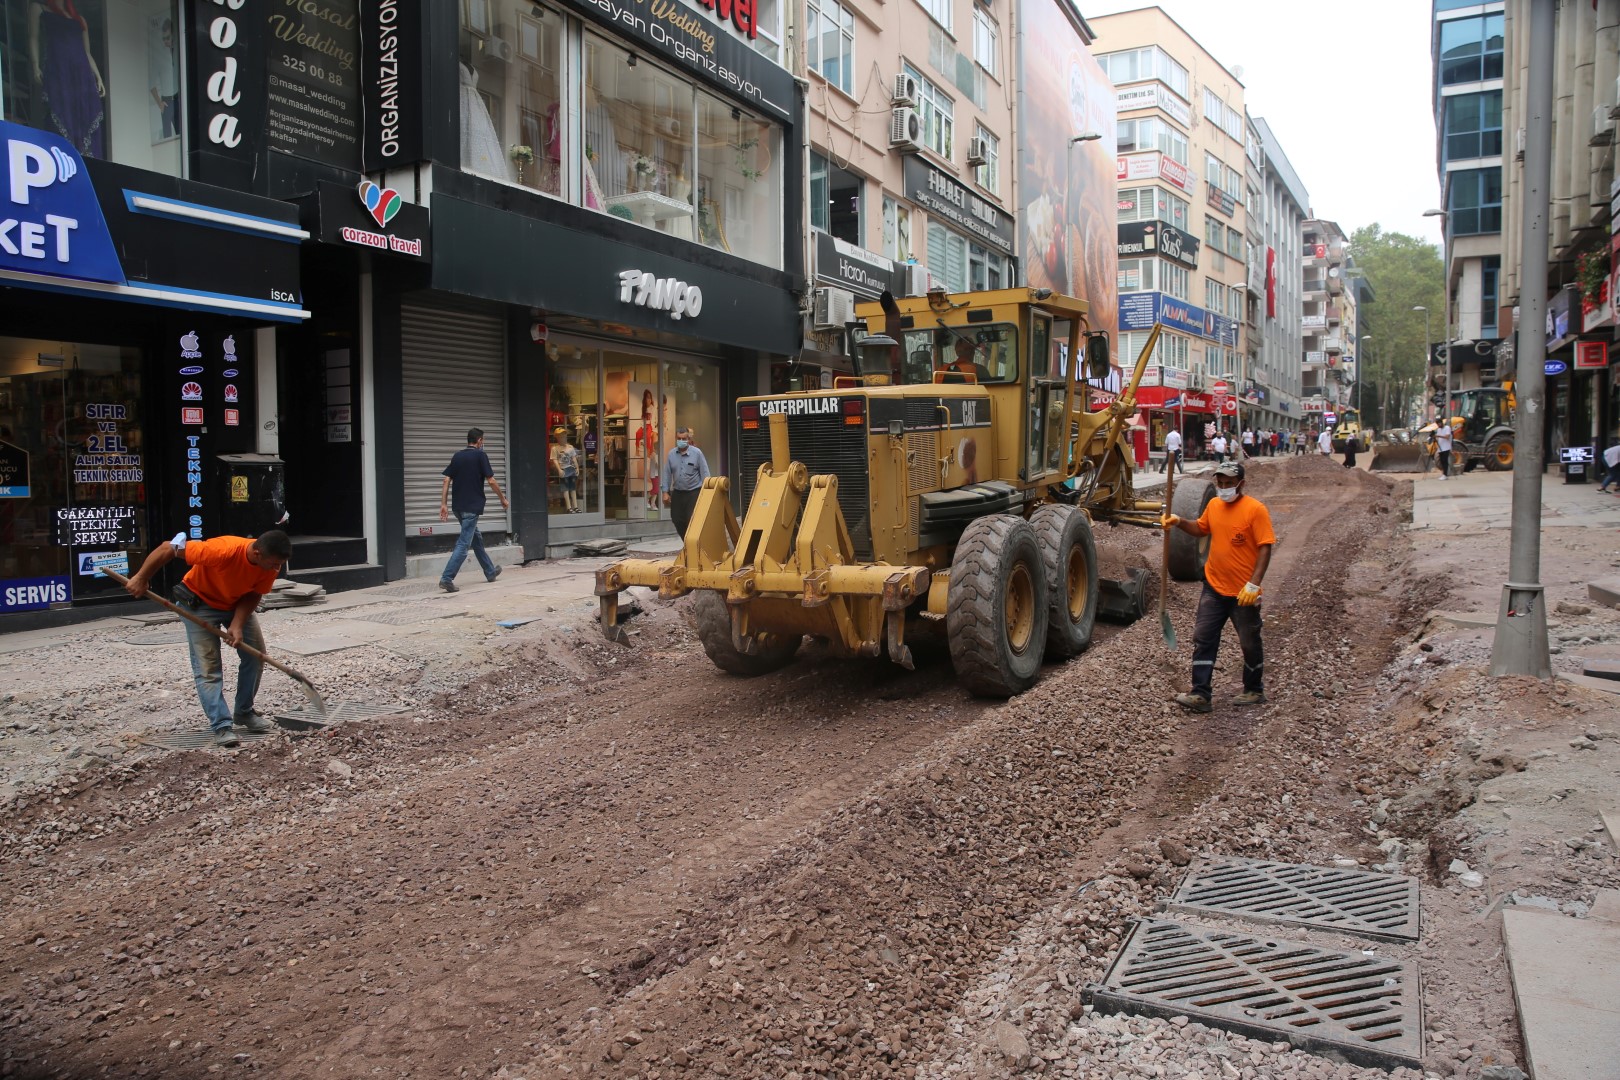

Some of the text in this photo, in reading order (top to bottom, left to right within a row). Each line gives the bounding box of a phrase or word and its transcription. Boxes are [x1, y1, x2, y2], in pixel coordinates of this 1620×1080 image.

[588, 0, 646, 34] ayan
[268, 14, 354, 71] Wedding
[282, 54, 343, 87] 325 00 88
[279, 79, 346, 110] masal_wedding
[268, 92, 355, 127] www.masalwedding.com
[270, 129, 298, 145] #kaftan
[343, 227, 421, 256] corazon travel
[839, 257, 867, 284] Hicran
[619, 269, 702, 320] PANÇO
[86, 404, 126, 420] SIFIR
[759, 397, 839, 417] CATERPILLAR
[962, 400, 977, 427] CAT
[98, 422, 117, 432] VE
[88, 435, 128, 453] 2.EL
[75, 455, 140, 466] ALIM SATIM
[187, 435, 203, 508] TEKNİK
[74, 466, 144, 483] TEKNİK SERVİS
[5, 580, 67, 605] SERVİS
